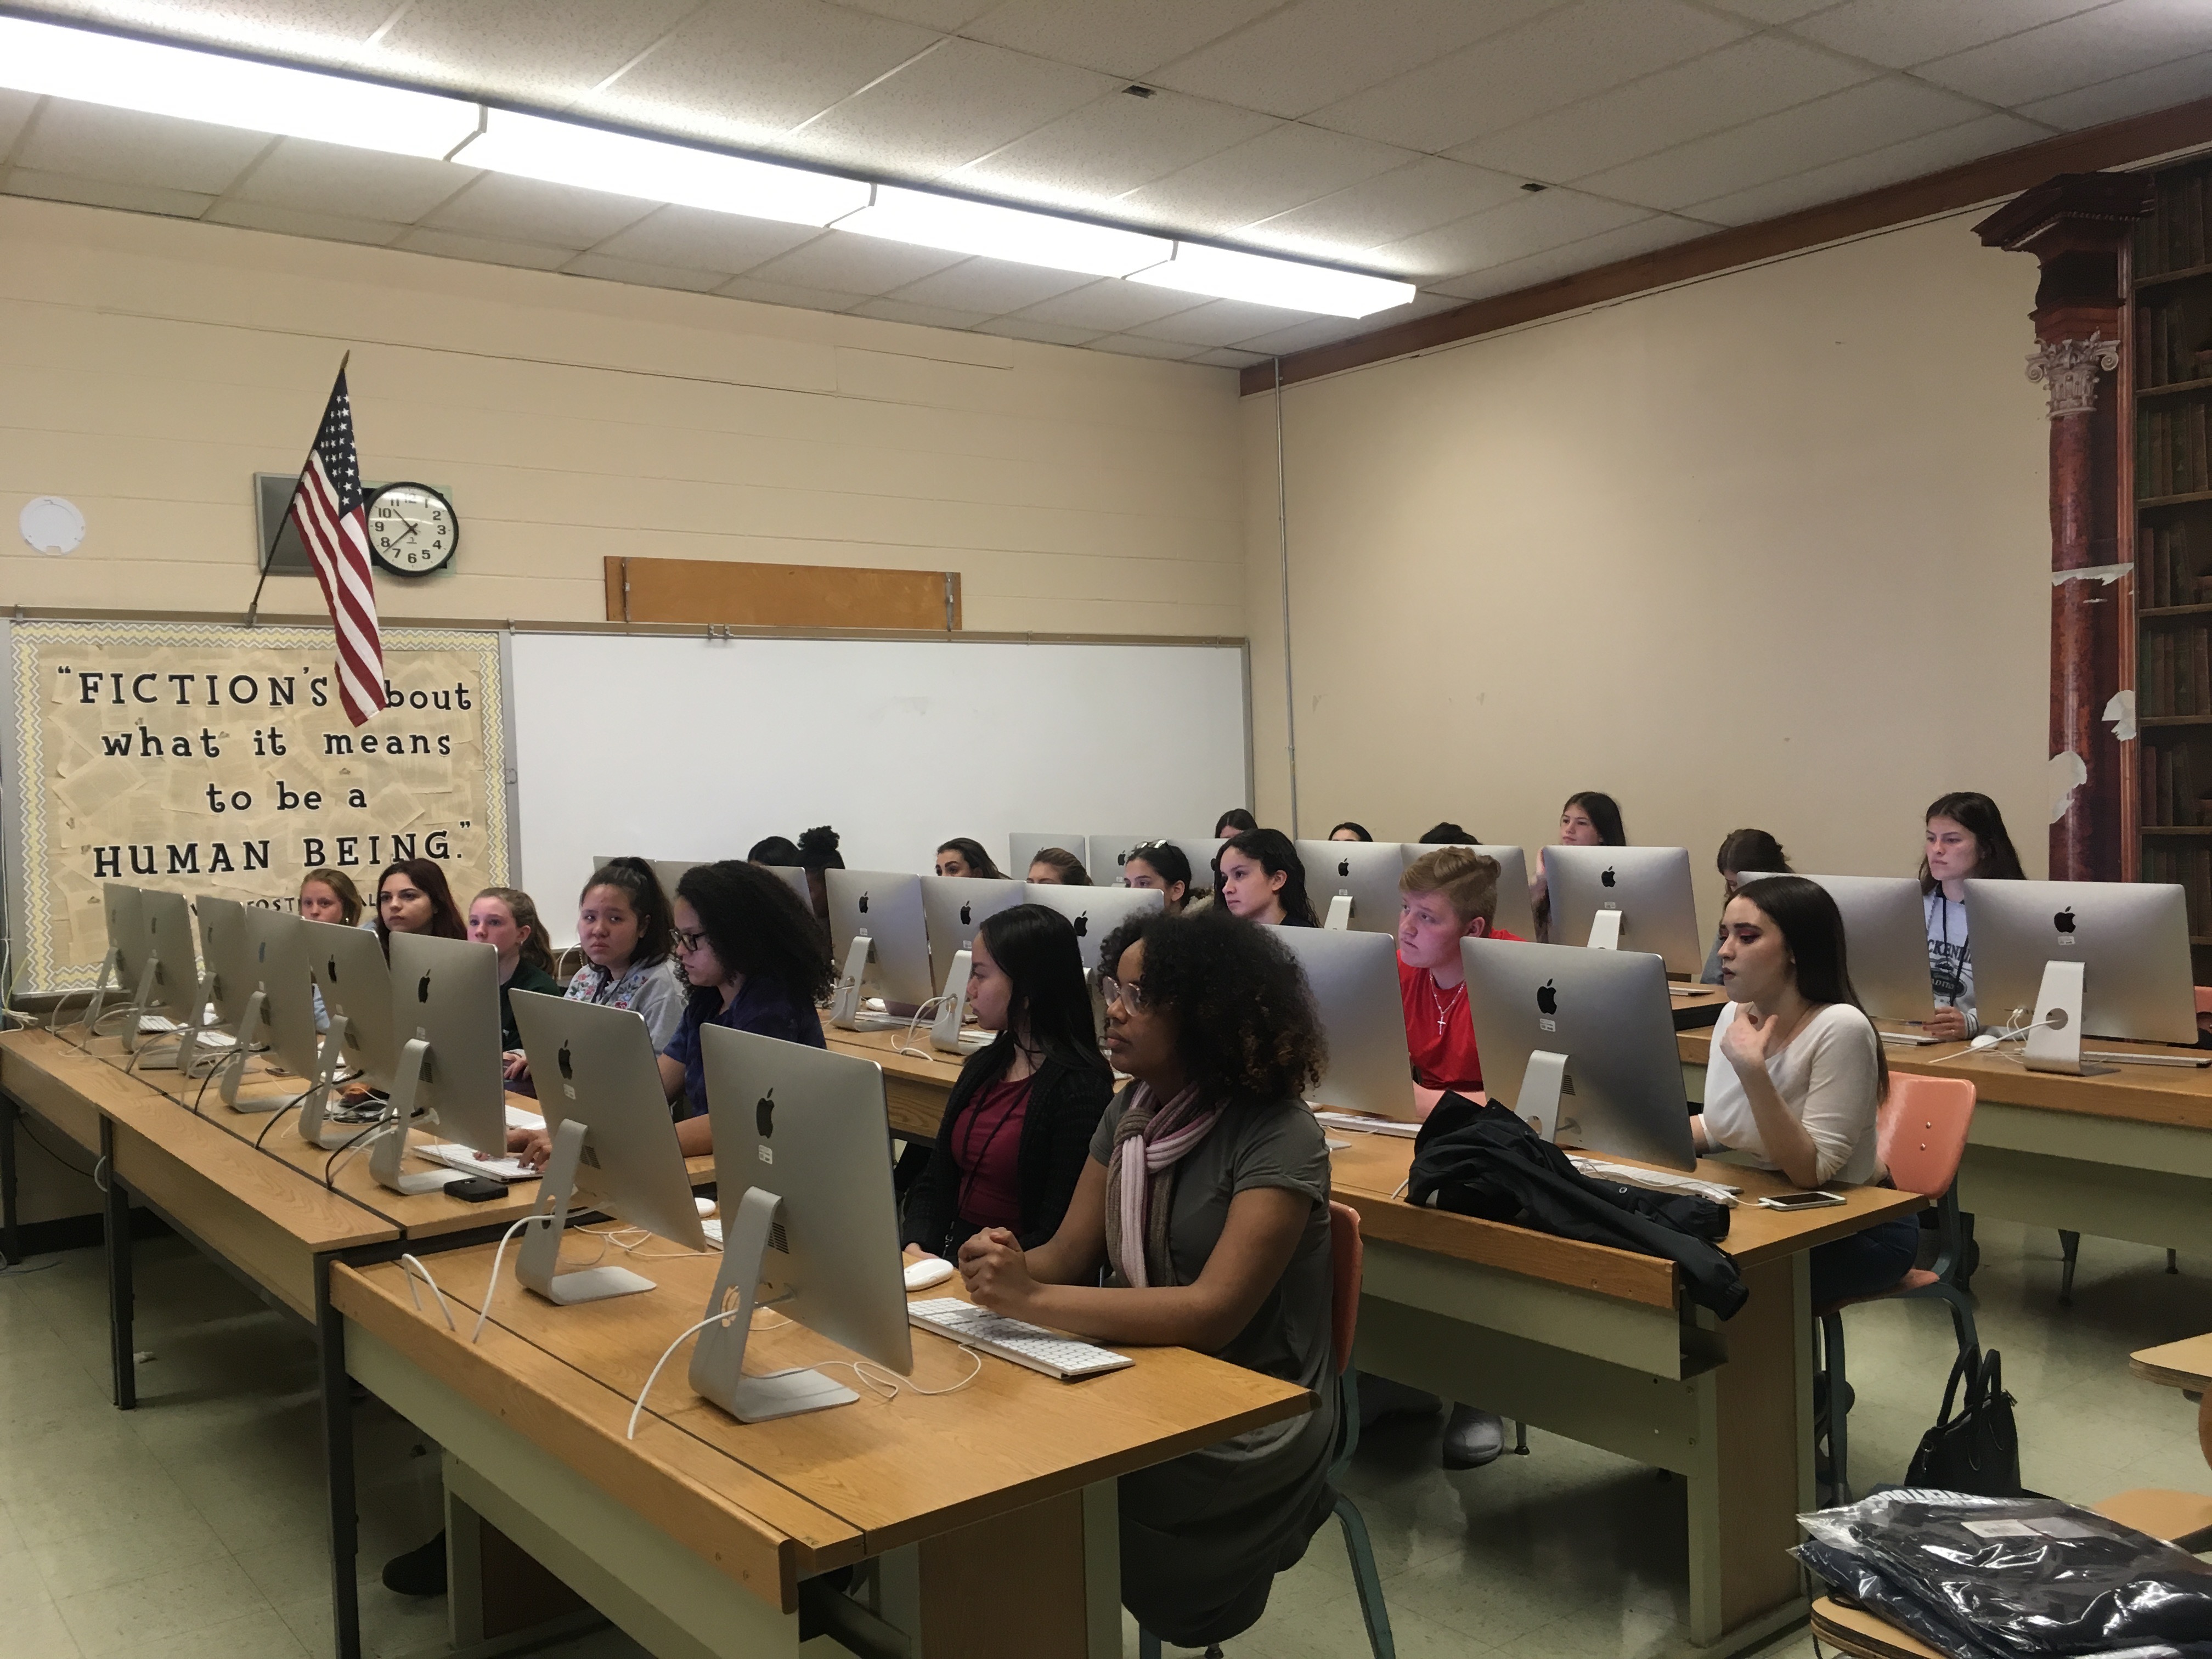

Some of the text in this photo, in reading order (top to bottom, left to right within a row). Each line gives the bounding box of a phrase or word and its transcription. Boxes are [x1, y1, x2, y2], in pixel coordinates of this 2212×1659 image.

[390, 498, 400, 507] 11
[378, 507, 392, 518] 10
[432, 510, 441, 521] 2
[374, 521, 385, 532] 9
[437, 524, 447, 535] 3
[380, 537, 390, 548] 8
[432, 539, 442, 550] 4
[392, 548, 401, 558] 7
[408, 552, 417, 563] 6
[421, 549, 431, 560] 5
[384, 679, 472, 711] bout
[101, 726, 451, 758] what it means
[206, 781, 367, 813] to be a
[93, 840, 270, 877] HUMAN
